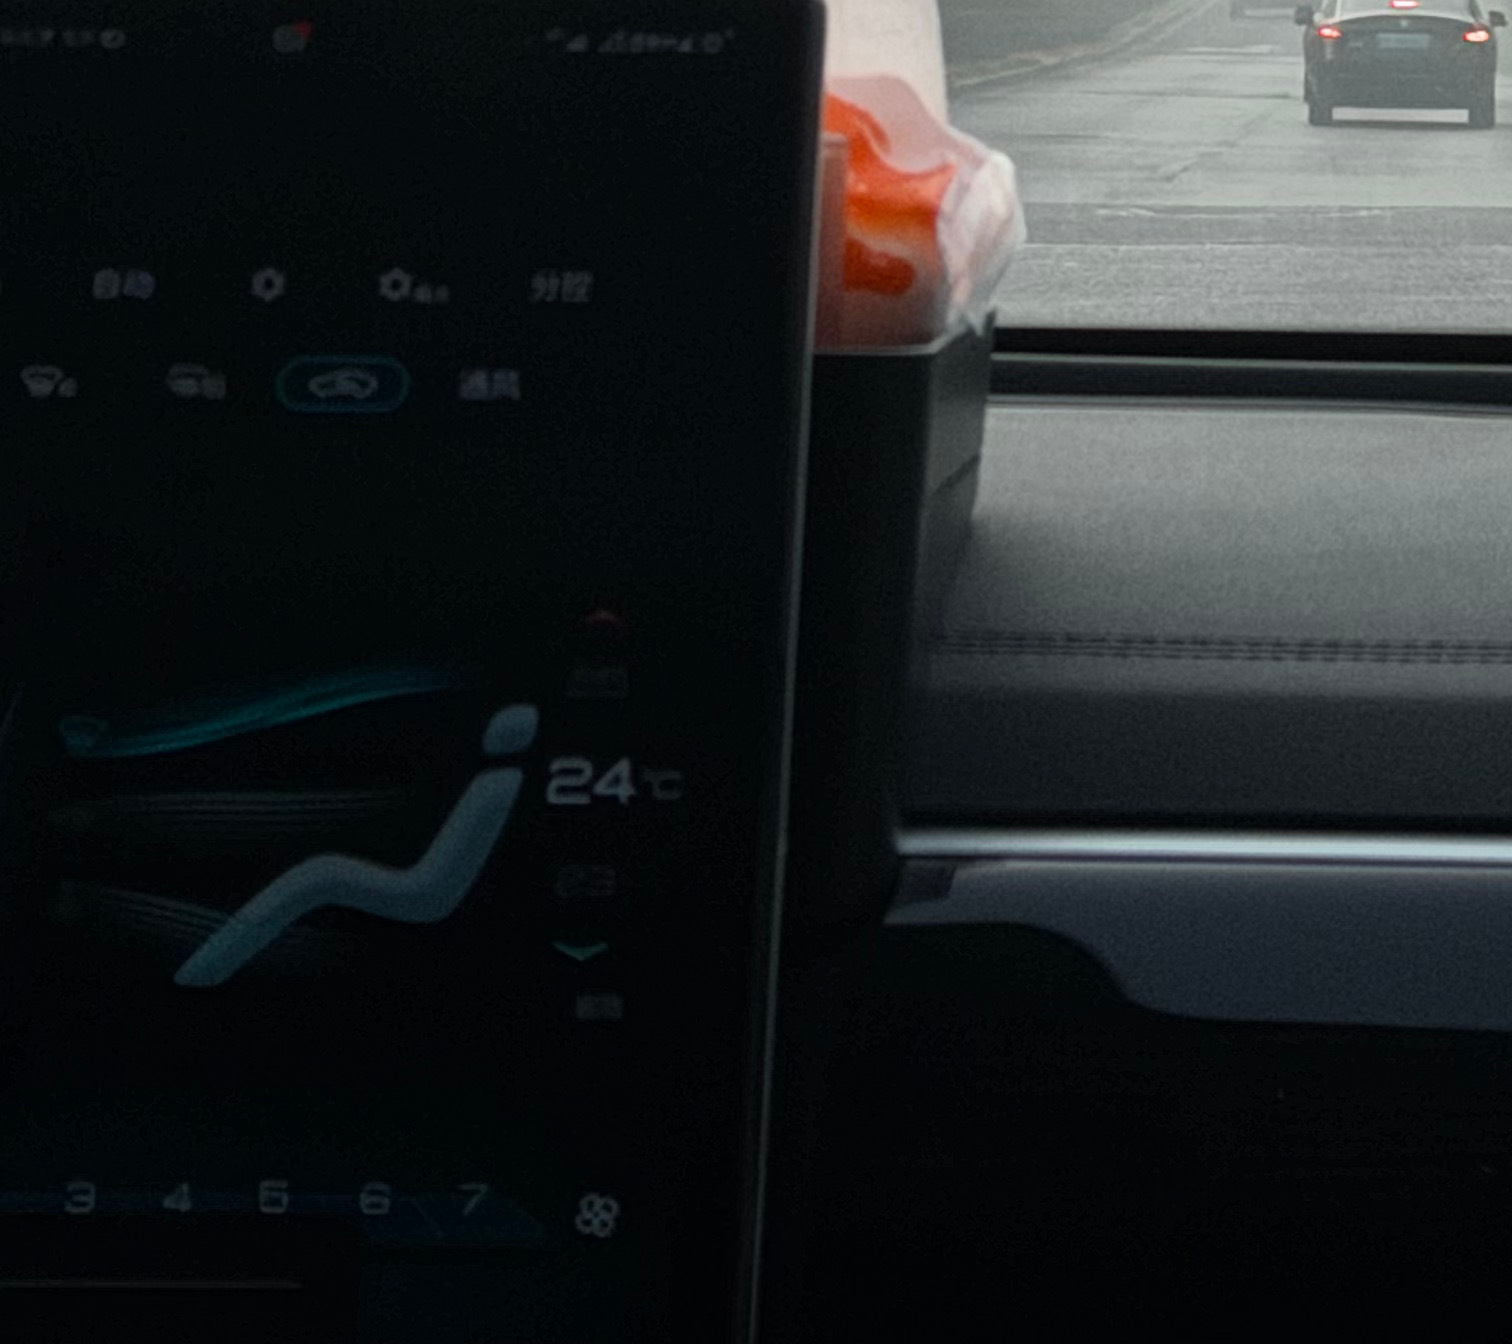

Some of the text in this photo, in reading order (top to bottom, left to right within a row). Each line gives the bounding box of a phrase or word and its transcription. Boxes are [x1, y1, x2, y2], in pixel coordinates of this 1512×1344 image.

[64, 1181, 97, 1214] 3
[161, 1181, 193, 1213] 4
[359, 1181, 392, 1215] 6
[457, 1183, 489, 1216] 7
